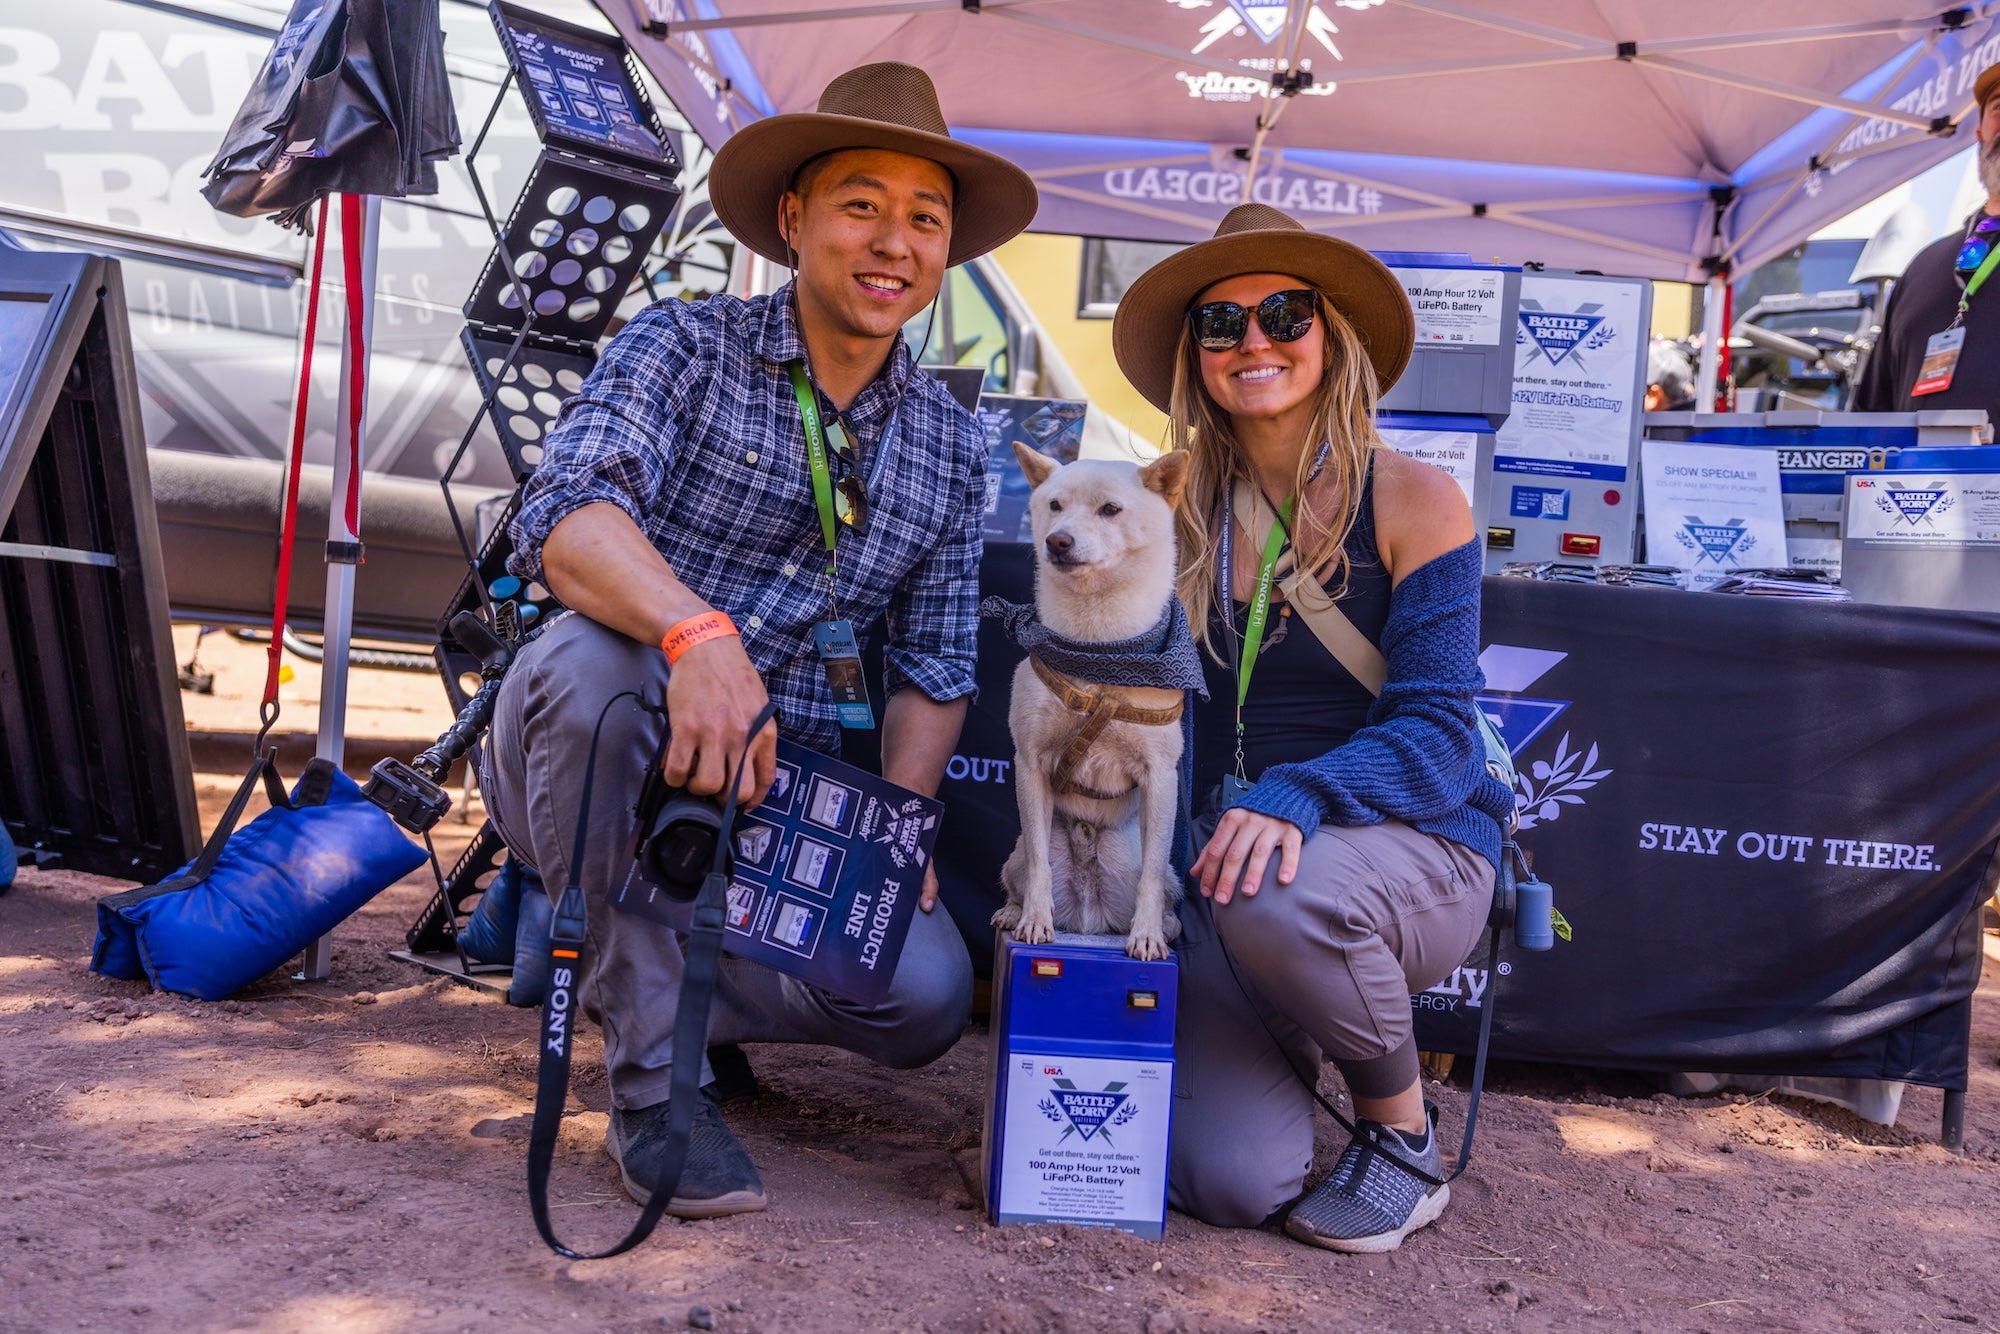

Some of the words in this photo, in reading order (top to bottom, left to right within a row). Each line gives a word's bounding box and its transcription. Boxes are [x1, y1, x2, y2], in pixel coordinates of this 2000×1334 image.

[552, 45, 604, 66] PRODUCT
[569, 59, 597, 73] LINE
[1408, 288, 1421, 296] 100
[1423, 288, 1442, 299] Amp
[1445, 289, 1465, 298] Hour
[1468, 290, 1476, 298] 12
[1478, 290, 1495, 299] Volt
[1452, 302, 1482, 312] Battery
[1528, 316, 1589, 330] BATTLE
[1535, 328, 1580, 341] BORN
[1550, 379, 1567, 388] stay
[1569, 380, 1582, 388] out
[1516, 391, 1539, 404] 12V
[1580, 395, 1622, 413] Battery
[806, 405, 822, 460] HONDA
[1415, 449, 1435, 459] Hour
[1437, 450, 1447, 459] 24
[1448, 450, 1465, 460] Volt
[1664, 465, 1699, 477] SHOW
[1894, 492, 1937, 501] BATTLE
[1899, 500, 1931, 509] BORN
[1694, 528, 1738, 538] BATTLE
[1700, 537, 1732, 546] BORN
[1792, 556, 1805, 565] Get
[1256, 562, 1273, 615] HONDA
[669, 619, 720, 650] OVERLAND
[946, 754, 1010, 784] OUT
[858, 796, 877, 842] dragonfly
[898, 818, 912, 847] BORN
[905, 816, 921, 855] BATTLE
[1639, 822, 1728, 857] STAY
[1736, 831, 1813, 863] OUT
[1823, 838, 1942, 873] THERE.
[844, 891, 871, 939] LINE
[860, 878, 900, 970] PRODUCT
[547, 967, 572, 1057] SONY
[1044, 1067, 1063, 1076] USA
[1063, 1094, 1115, 1107] BATTLE
[1069, 1106, 1108, 1117] BORN
[1039, 1148, 1051, 1157] Get
[1065, 1150, 1085, 1159] there,
[1087, 1152, 1102, 1161] stay
[1028, 1161, 1046, 1169] 100
[1048, 1161, 1074, 1172] Amp
[1076, 1163, 1103, 1173] Hour
[1107, 1165, 1118, 1173] 12
[1120, 1165, 1140, 1175] Volt
[1086, 1175, 1124, 1186] Battery
